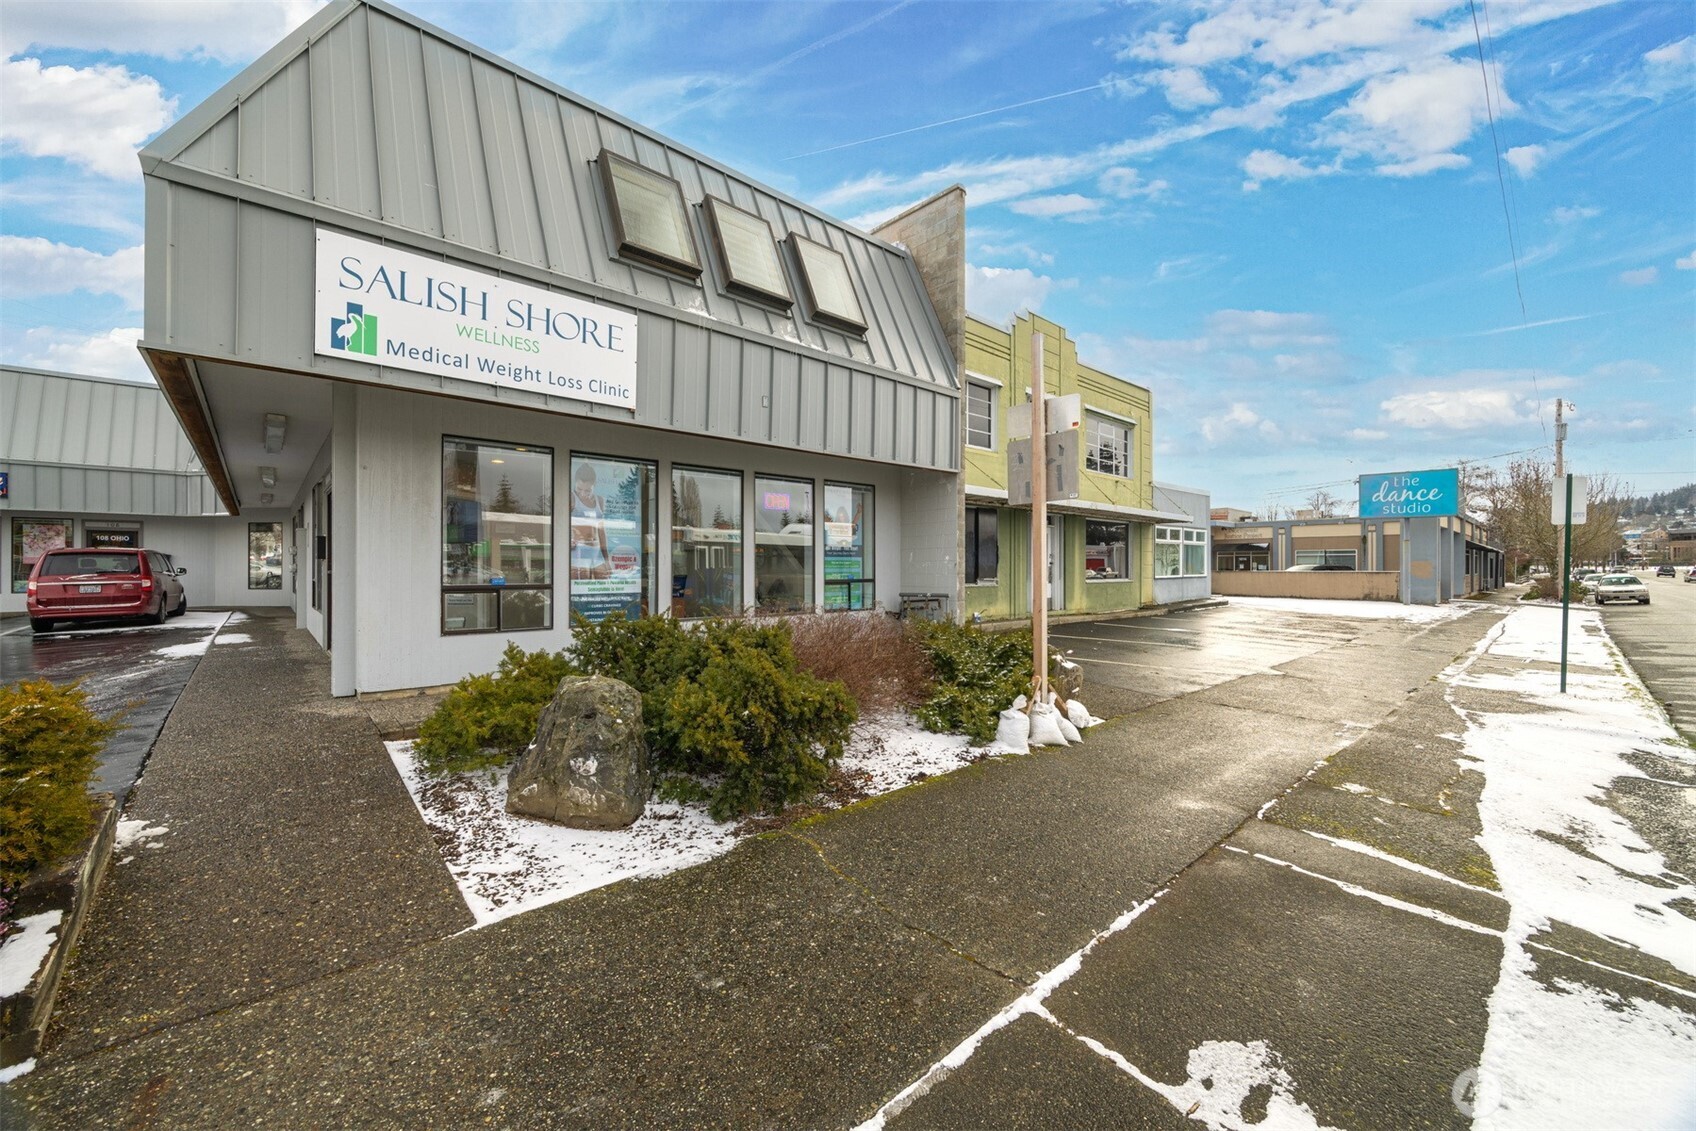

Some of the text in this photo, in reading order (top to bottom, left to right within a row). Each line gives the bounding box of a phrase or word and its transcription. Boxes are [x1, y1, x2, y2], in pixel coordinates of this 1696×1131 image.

[339, 256, 624, 353] SALISH SHORE
[455, 323, 540, 353] WELLNESS
[386, 339, 629, 399] Medical Weight Loss Clinic
[1372, 481, 1443, 502] dance
[1393, 476, 1420, 487] the
[1382, 502, 1431, 514] studio
